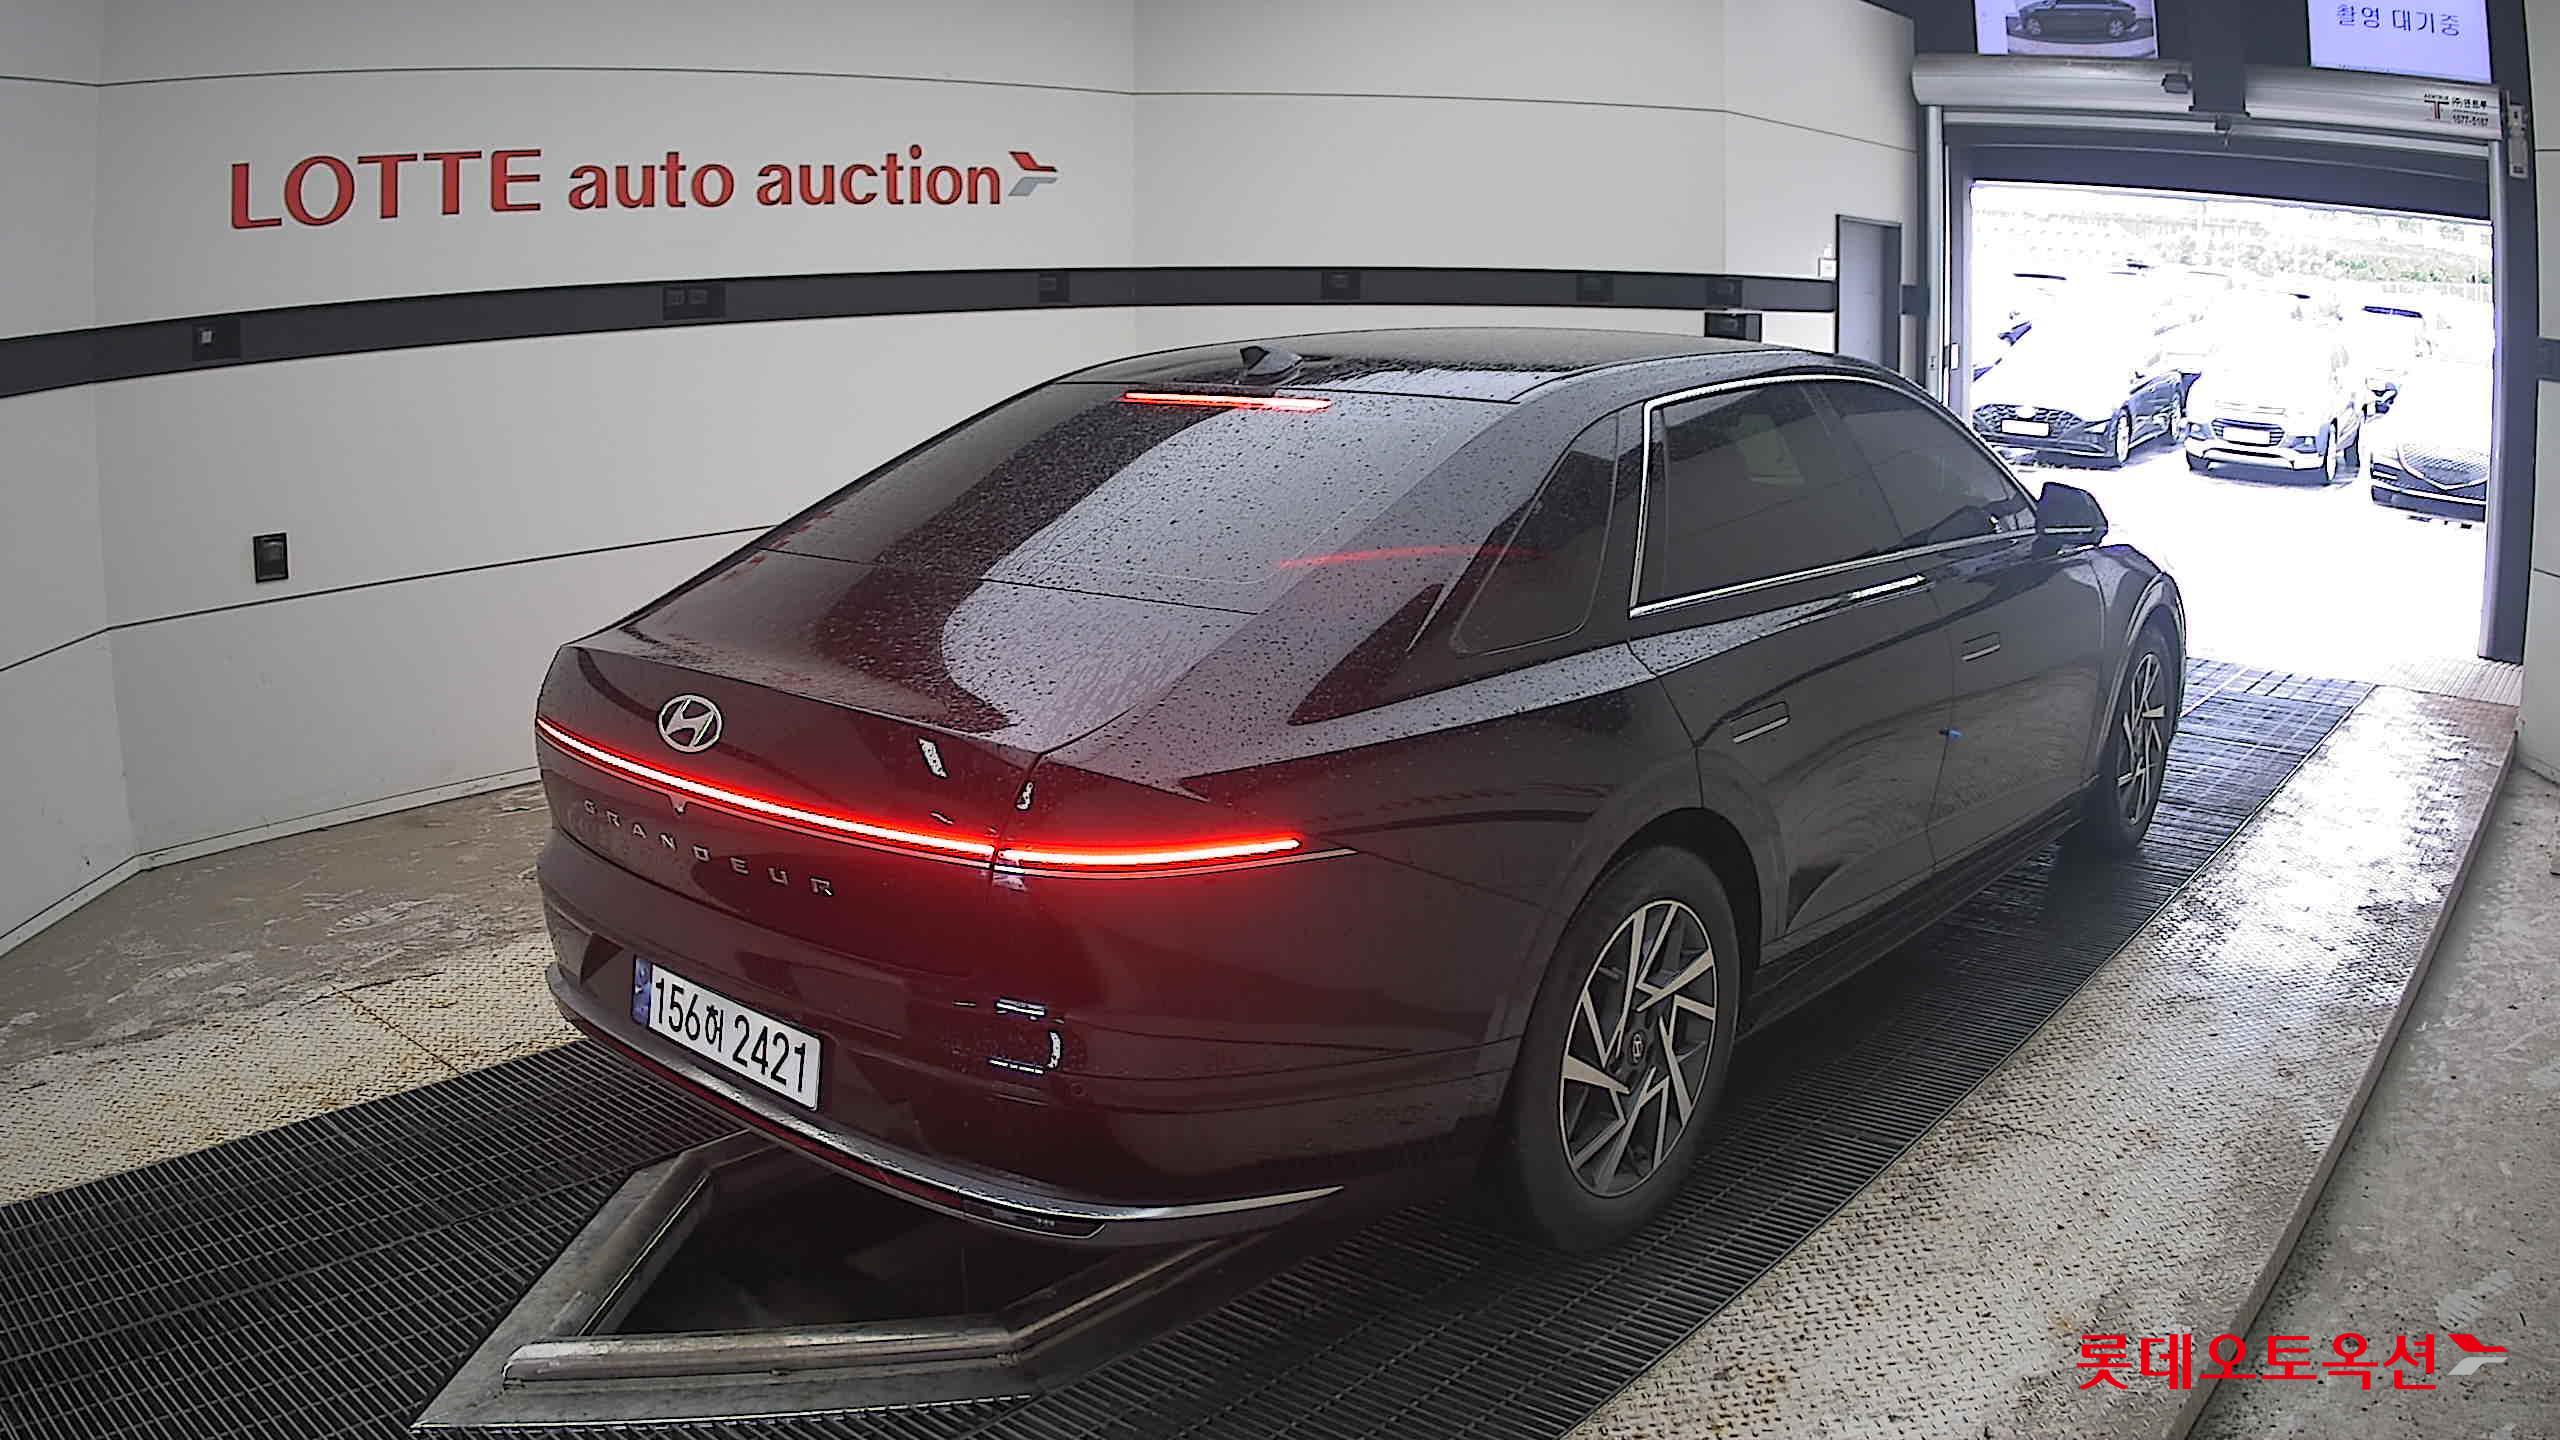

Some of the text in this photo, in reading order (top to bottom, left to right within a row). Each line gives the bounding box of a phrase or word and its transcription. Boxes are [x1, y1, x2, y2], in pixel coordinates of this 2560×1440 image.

[2336, 4, 2460, 37] 촬영 대기중
[230, 144, 1001, 230] LOTTE auto auction
[582, 798, 834, 898] GRANDEUR
[655, 977, 807, 1093] 156허 2421
